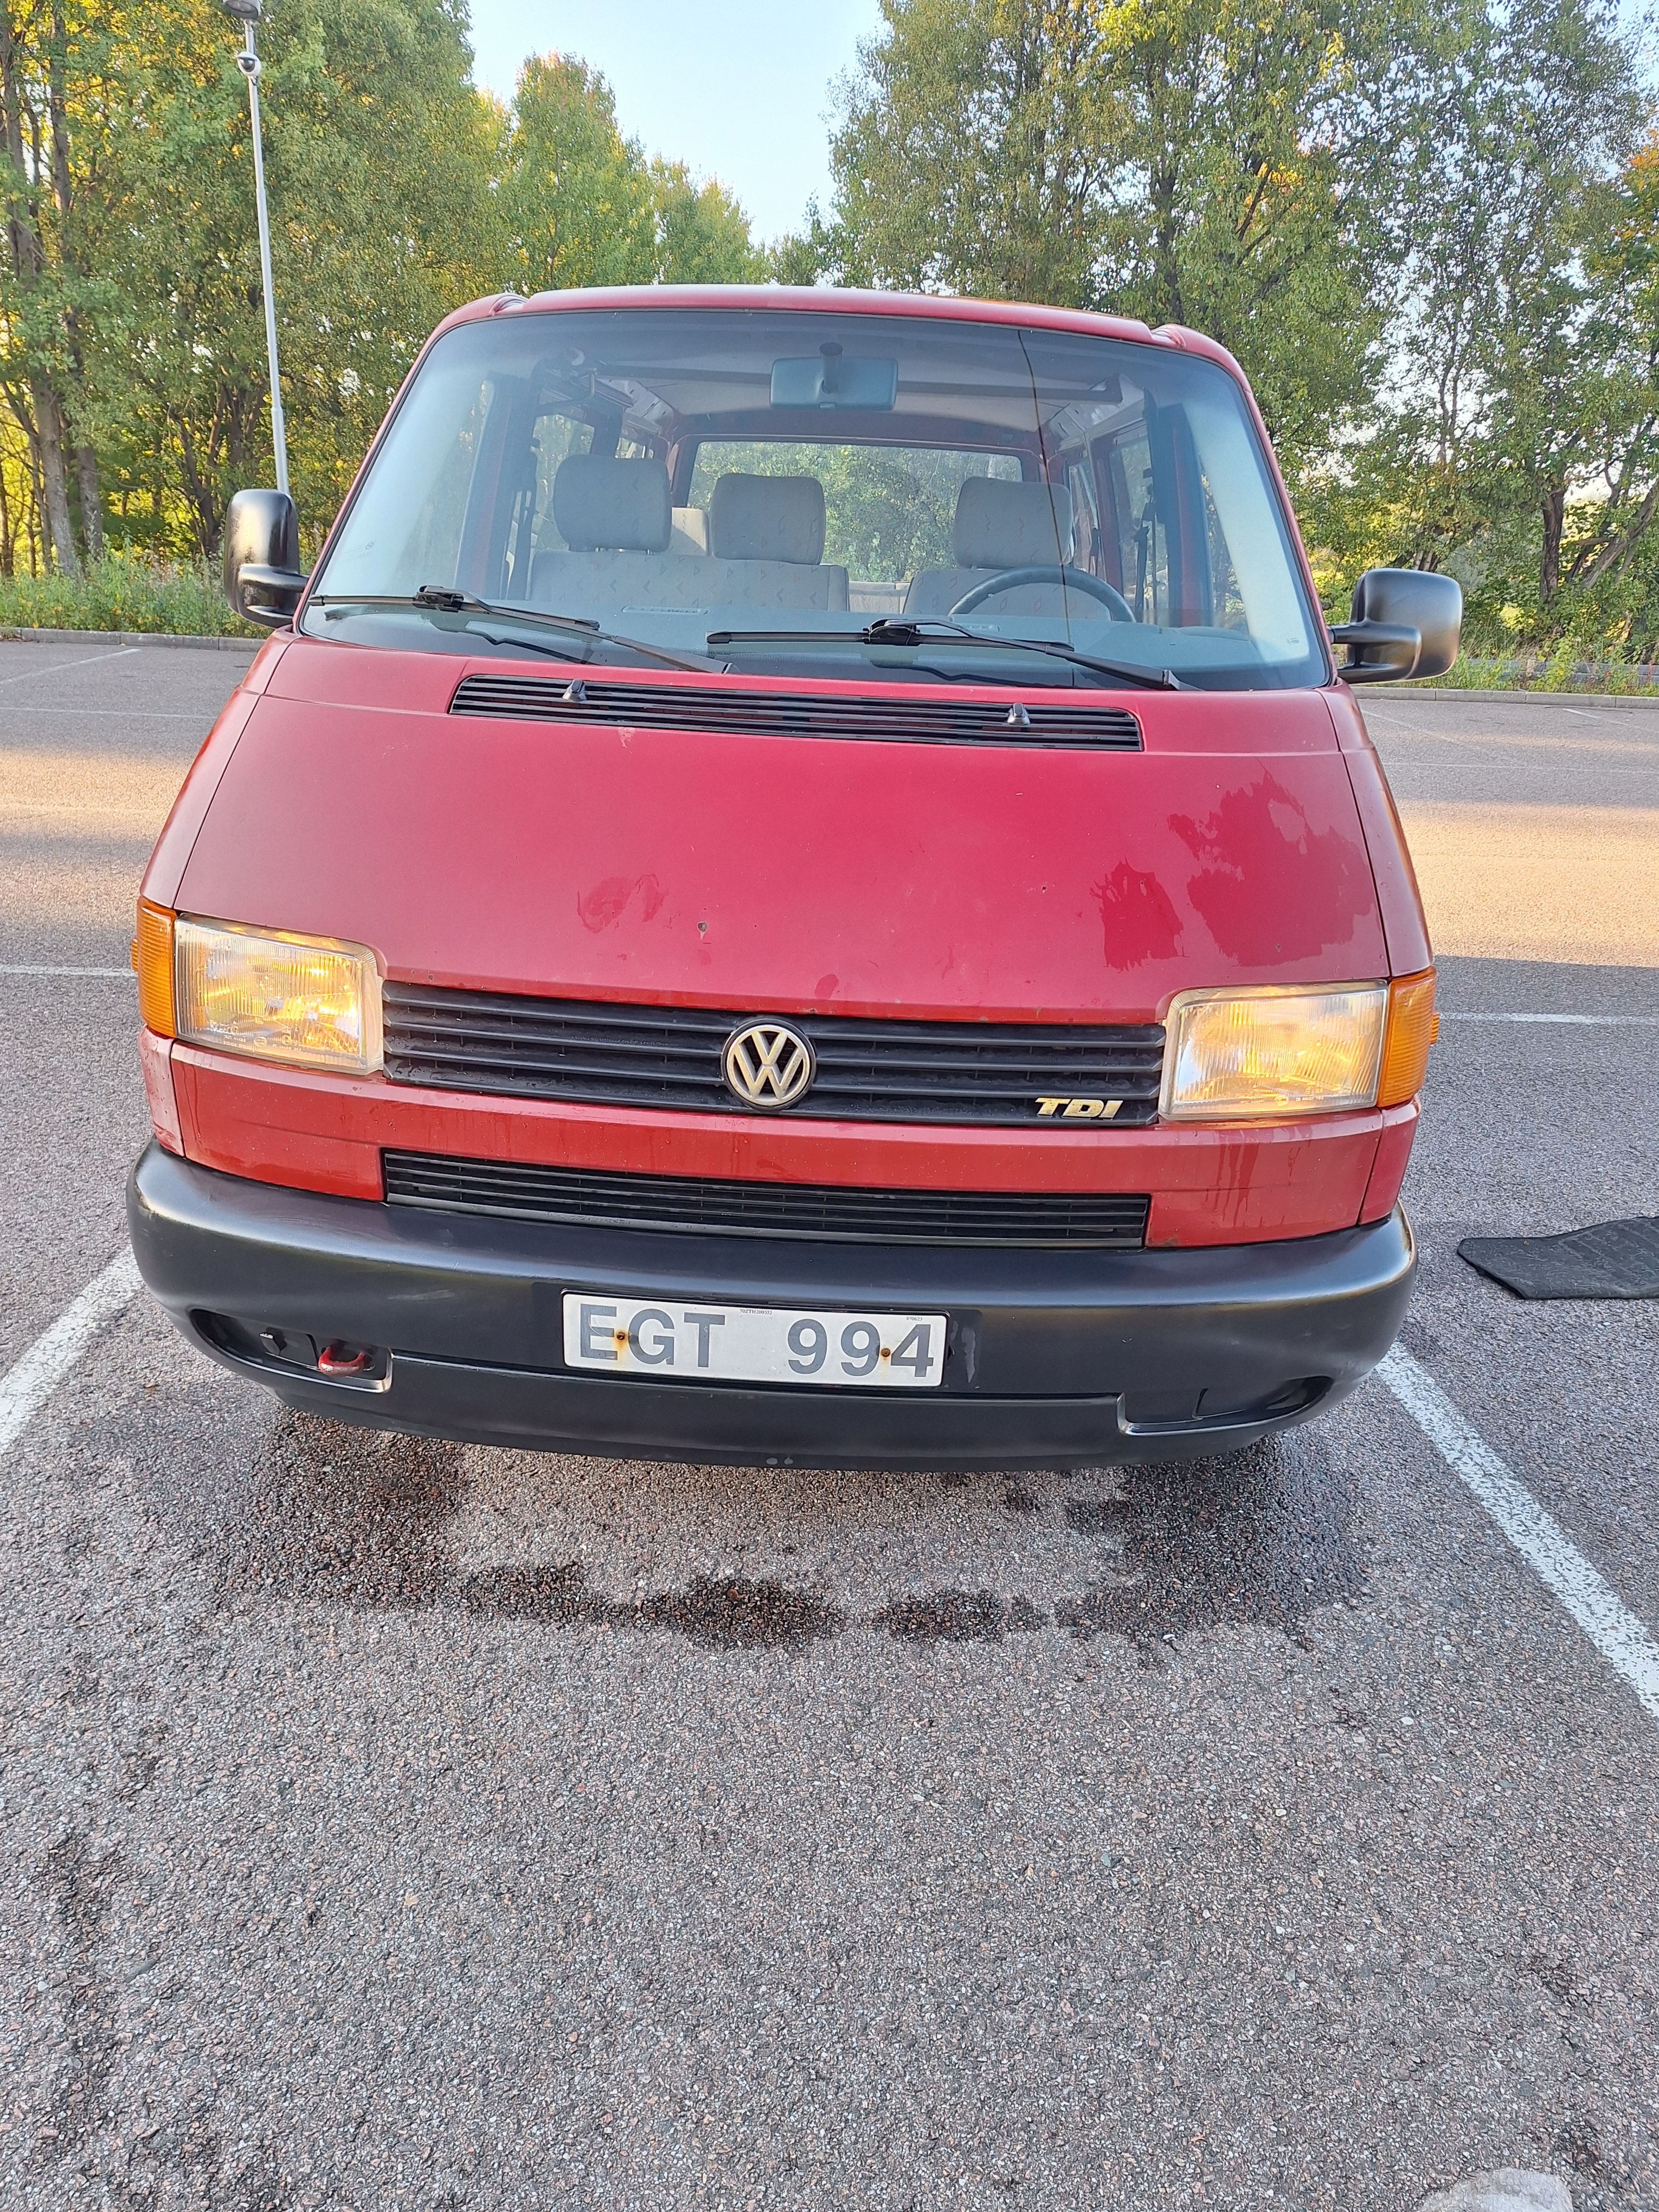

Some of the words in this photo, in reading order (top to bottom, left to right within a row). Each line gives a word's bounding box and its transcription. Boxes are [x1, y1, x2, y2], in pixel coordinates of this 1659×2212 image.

[726, 1025, 810, 1107] VW
[1035, 1097, 1123, 1119] TDI
[580, 1303, 725, 1368] EGT
[787, 1319, 934, 1378] 994
